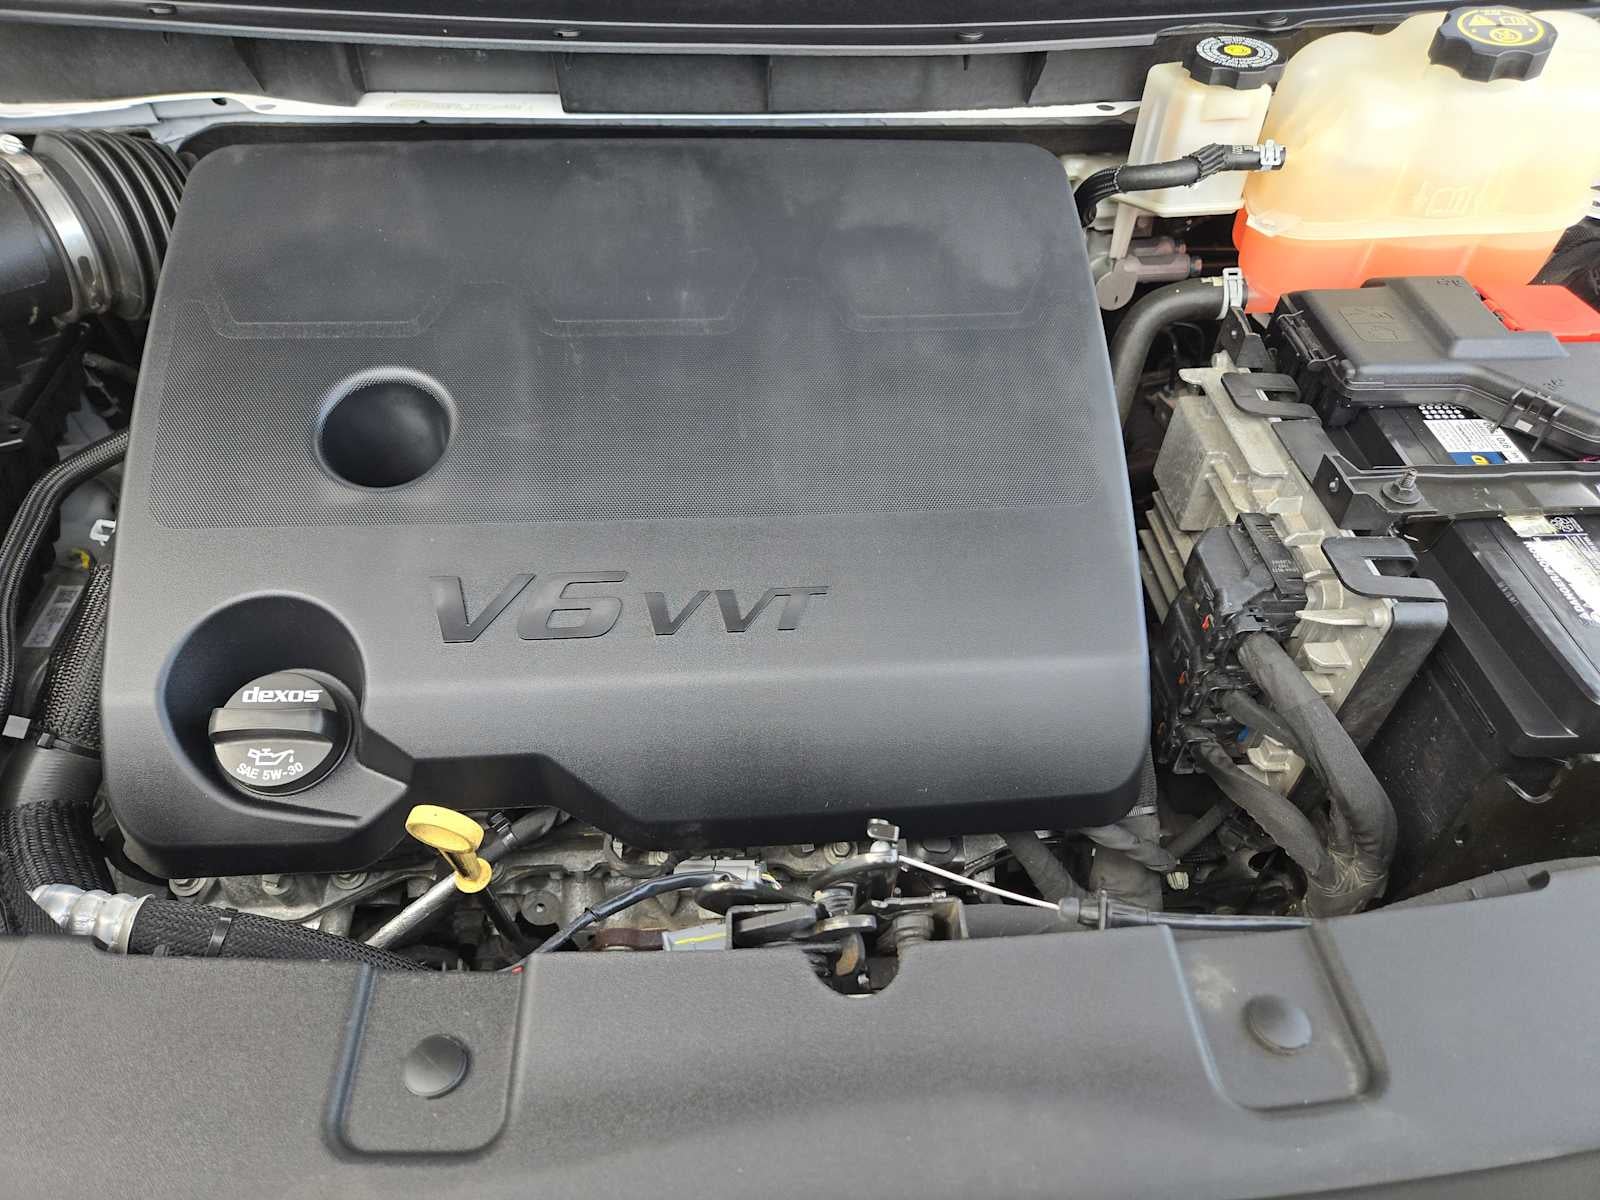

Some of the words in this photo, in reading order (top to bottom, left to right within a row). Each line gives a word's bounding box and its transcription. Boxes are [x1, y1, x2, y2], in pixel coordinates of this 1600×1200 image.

[430, 570, 629, 643] V6
[644, 585, 831, 636] VVT
[242, 687, 322, 703] dexos
[236, 763, 259, 779] SAE
[262, 762, 304, 781] 5W-30
